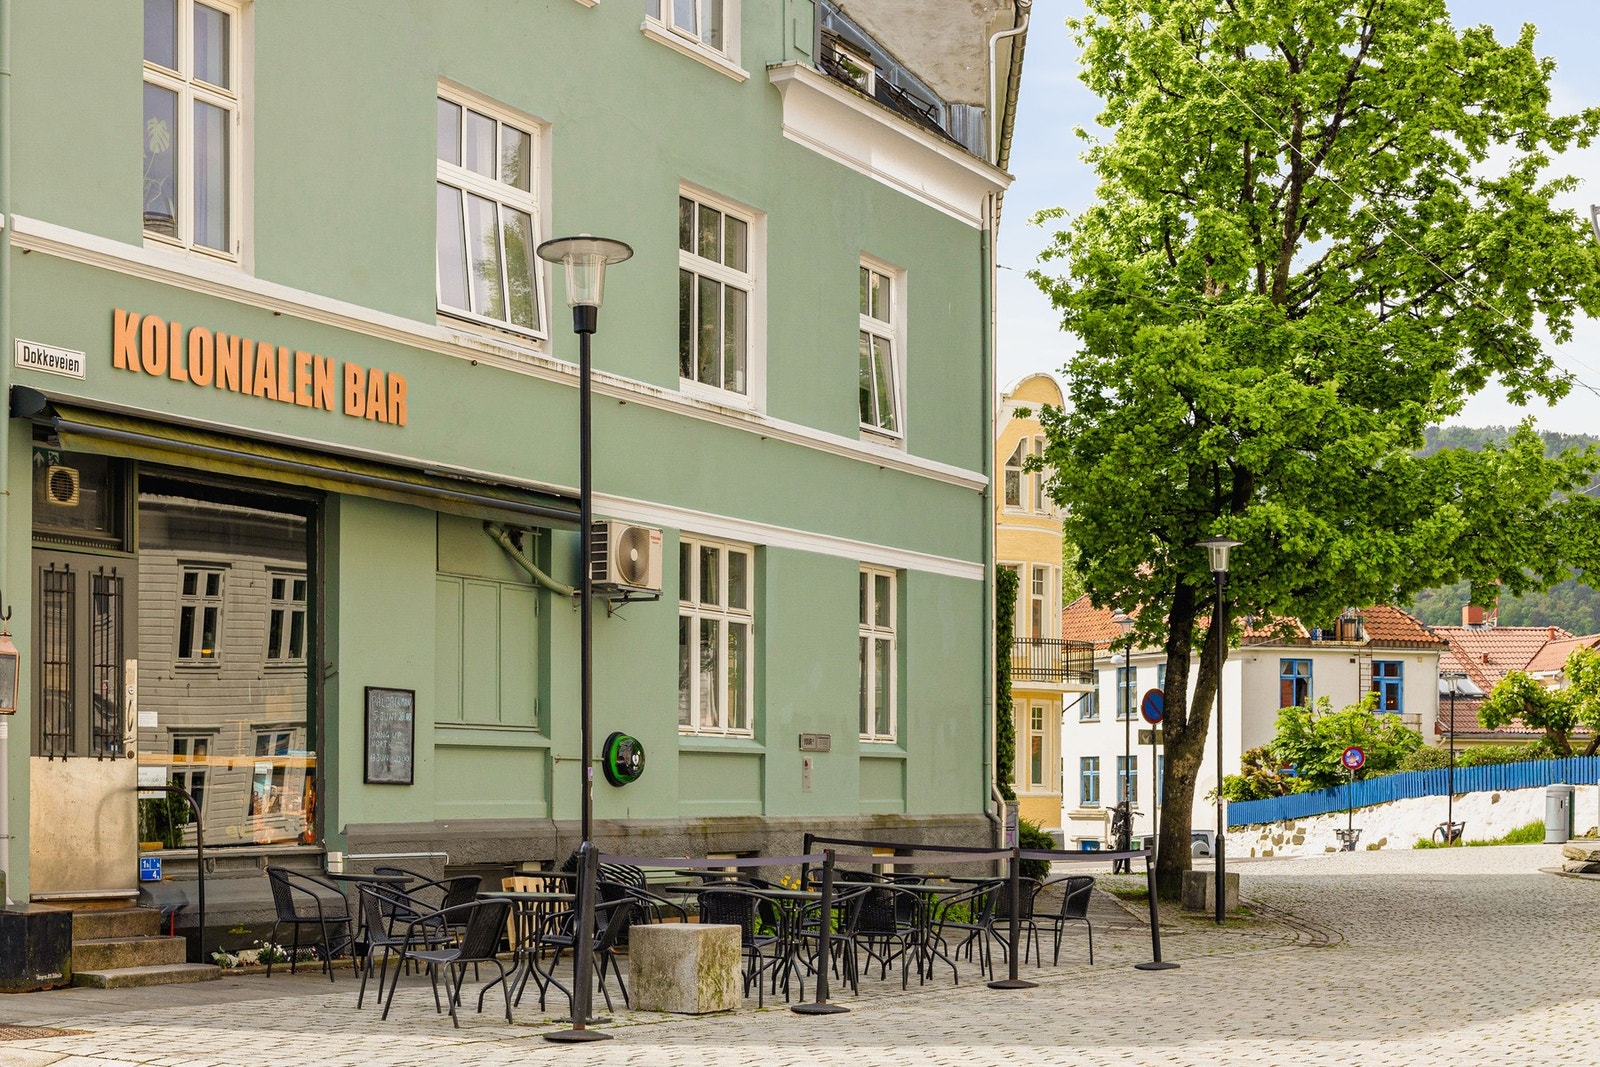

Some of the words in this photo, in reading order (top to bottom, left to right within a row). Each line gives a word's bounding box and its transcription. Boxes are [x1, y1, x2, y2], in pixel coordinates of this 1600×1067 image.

[23, 345, 80, 373] Dokkeveien
[113, 308, 335, 411] KOLONIALEN
[344, 361, 408, 426] BAR
